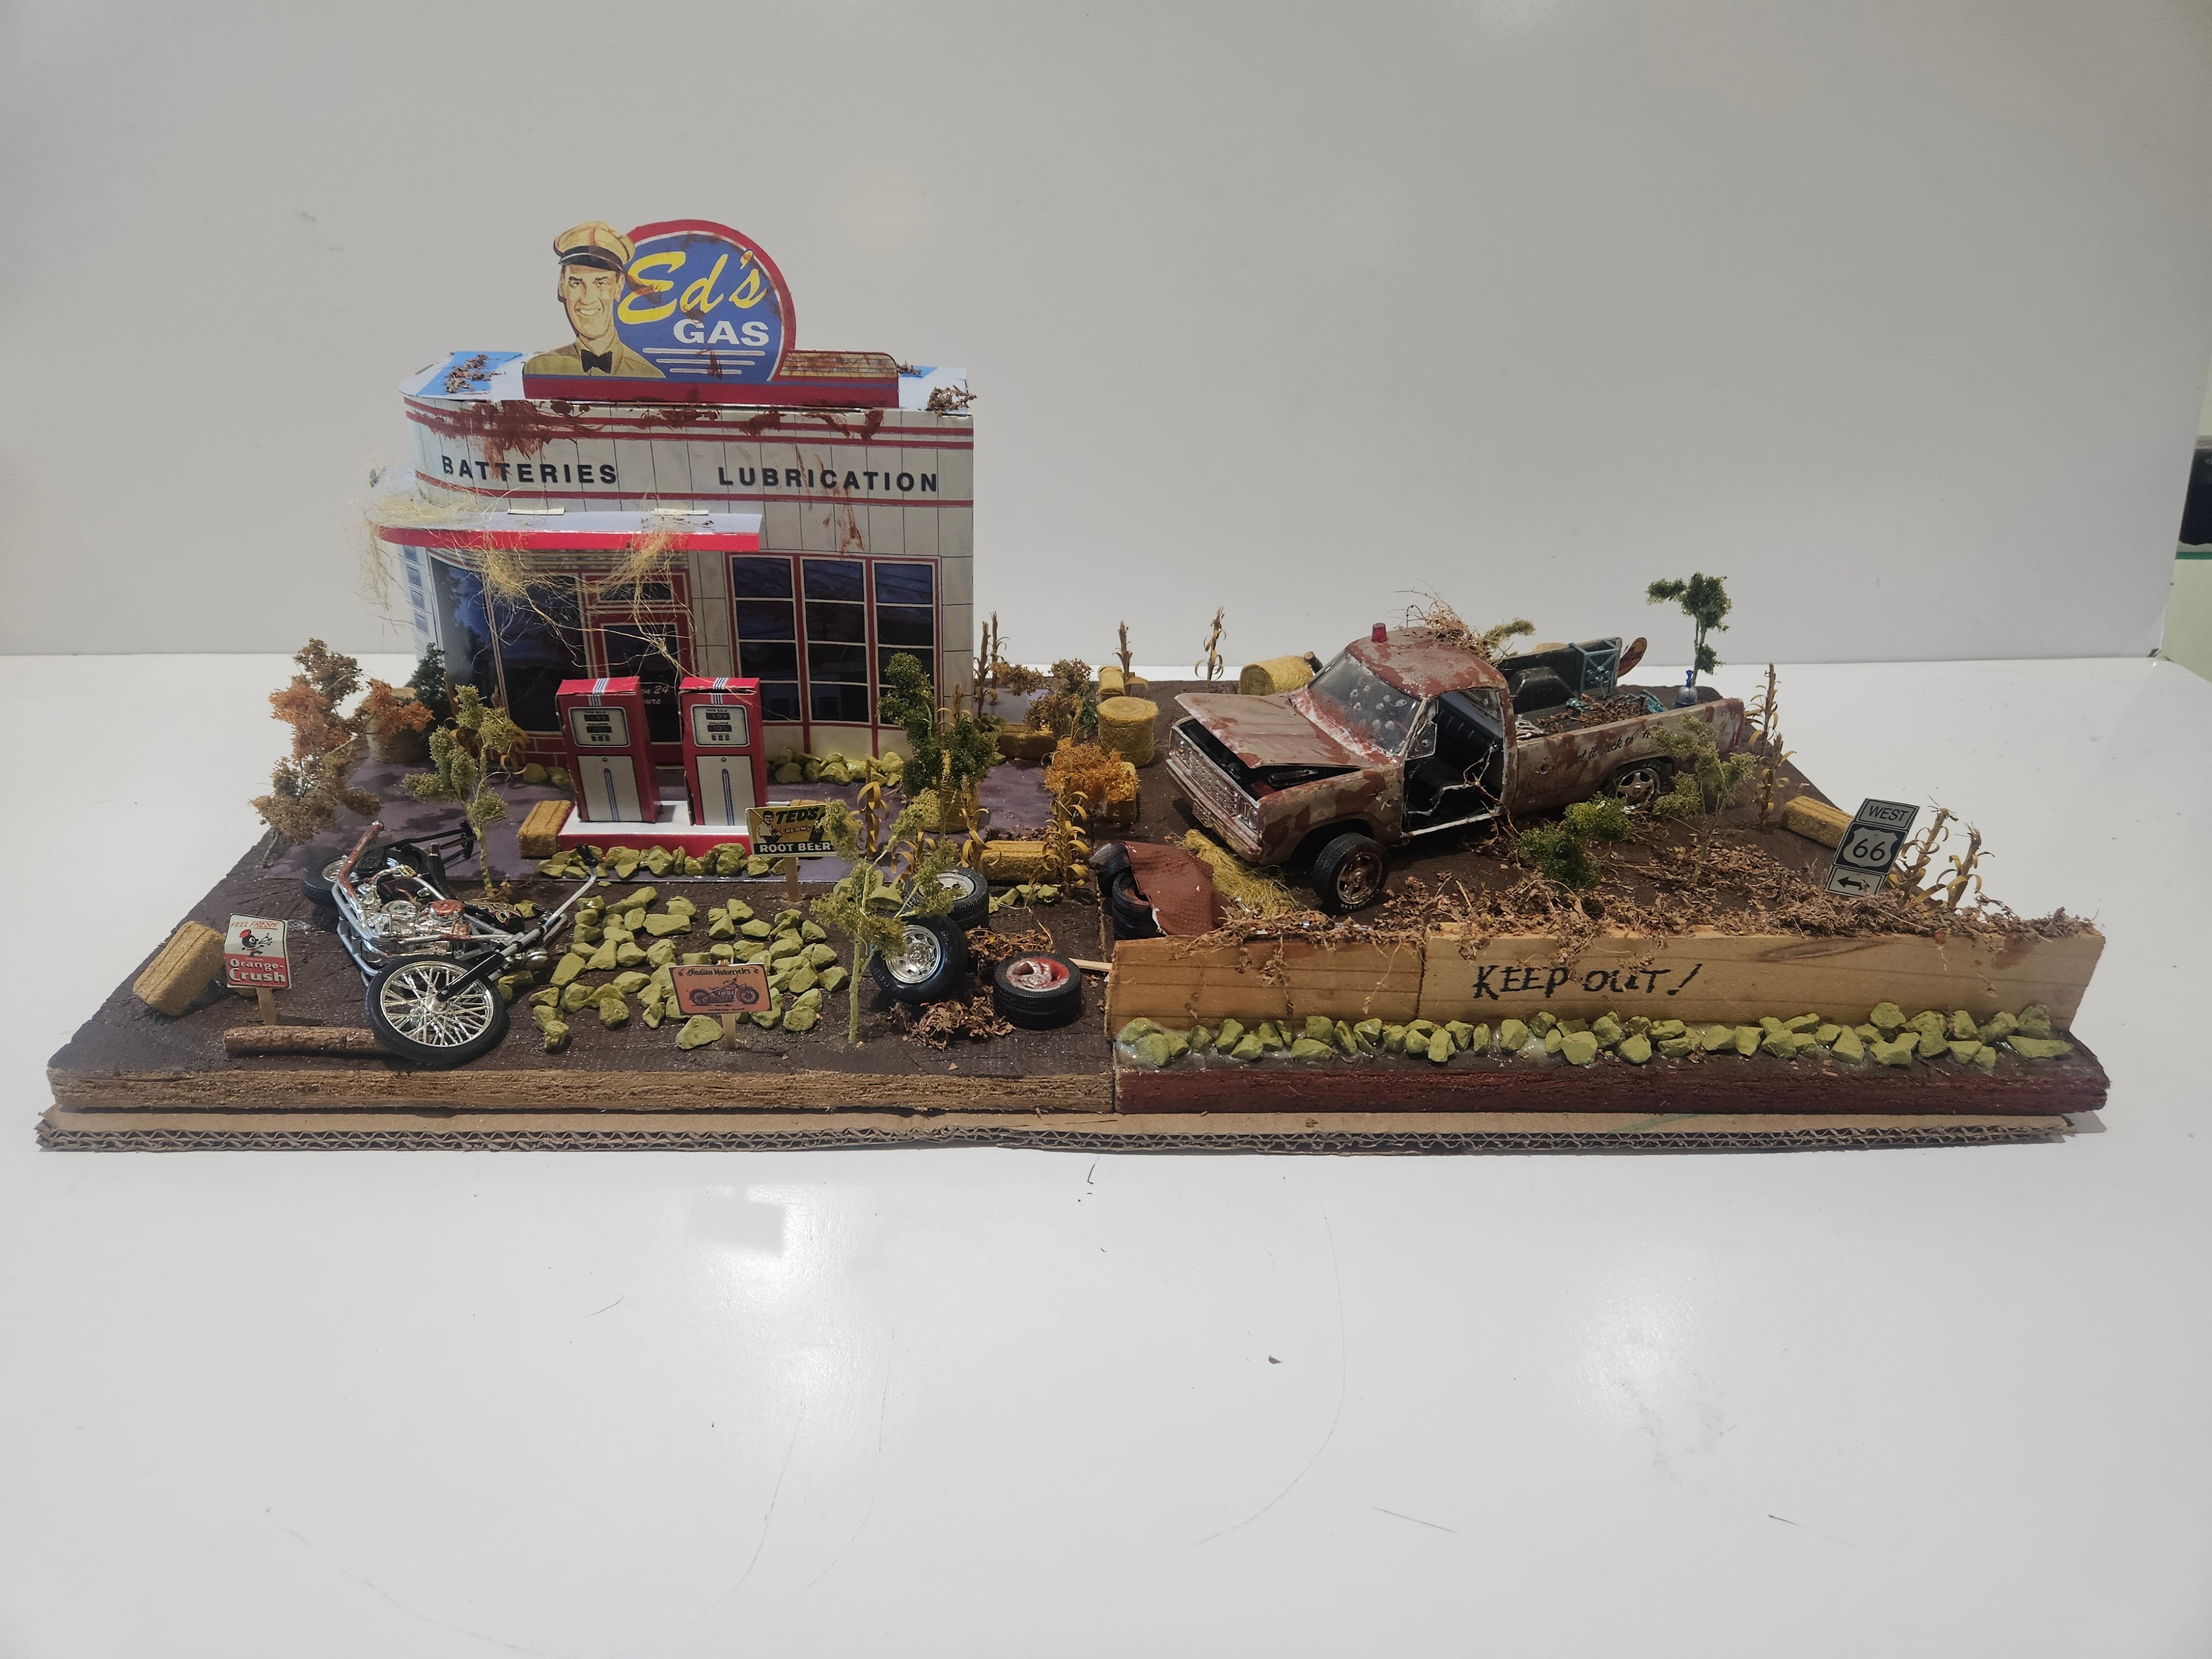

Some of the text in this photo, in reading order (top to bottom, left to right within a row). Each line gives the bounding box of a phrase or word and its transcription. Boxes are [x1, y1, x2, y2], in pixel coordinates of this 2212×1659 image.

[616, 249, 768, 324] Ed's
[672, 320, 770, 347] GAS
[442, 455, 617, 484] BATTERIES
[718, 467, 937, 492] LUBRICATION
[653, 685, 669, 694] 24
[775, 807, 820, 824] TED'S
[1868, 805, 1910, 822] WEST
[781, 825, 811, 834] CREAMY
[759, 842, 831, 853] ROOT BEER
[1853, 838, 1885, 861] 66
[229, 958, 284, 972] Orange-
[686, 968, 751, 978] Indian Motorcycles
[228, 968, 286, 983] Crush
[1471, 965, 1569, 1001] KEEP
